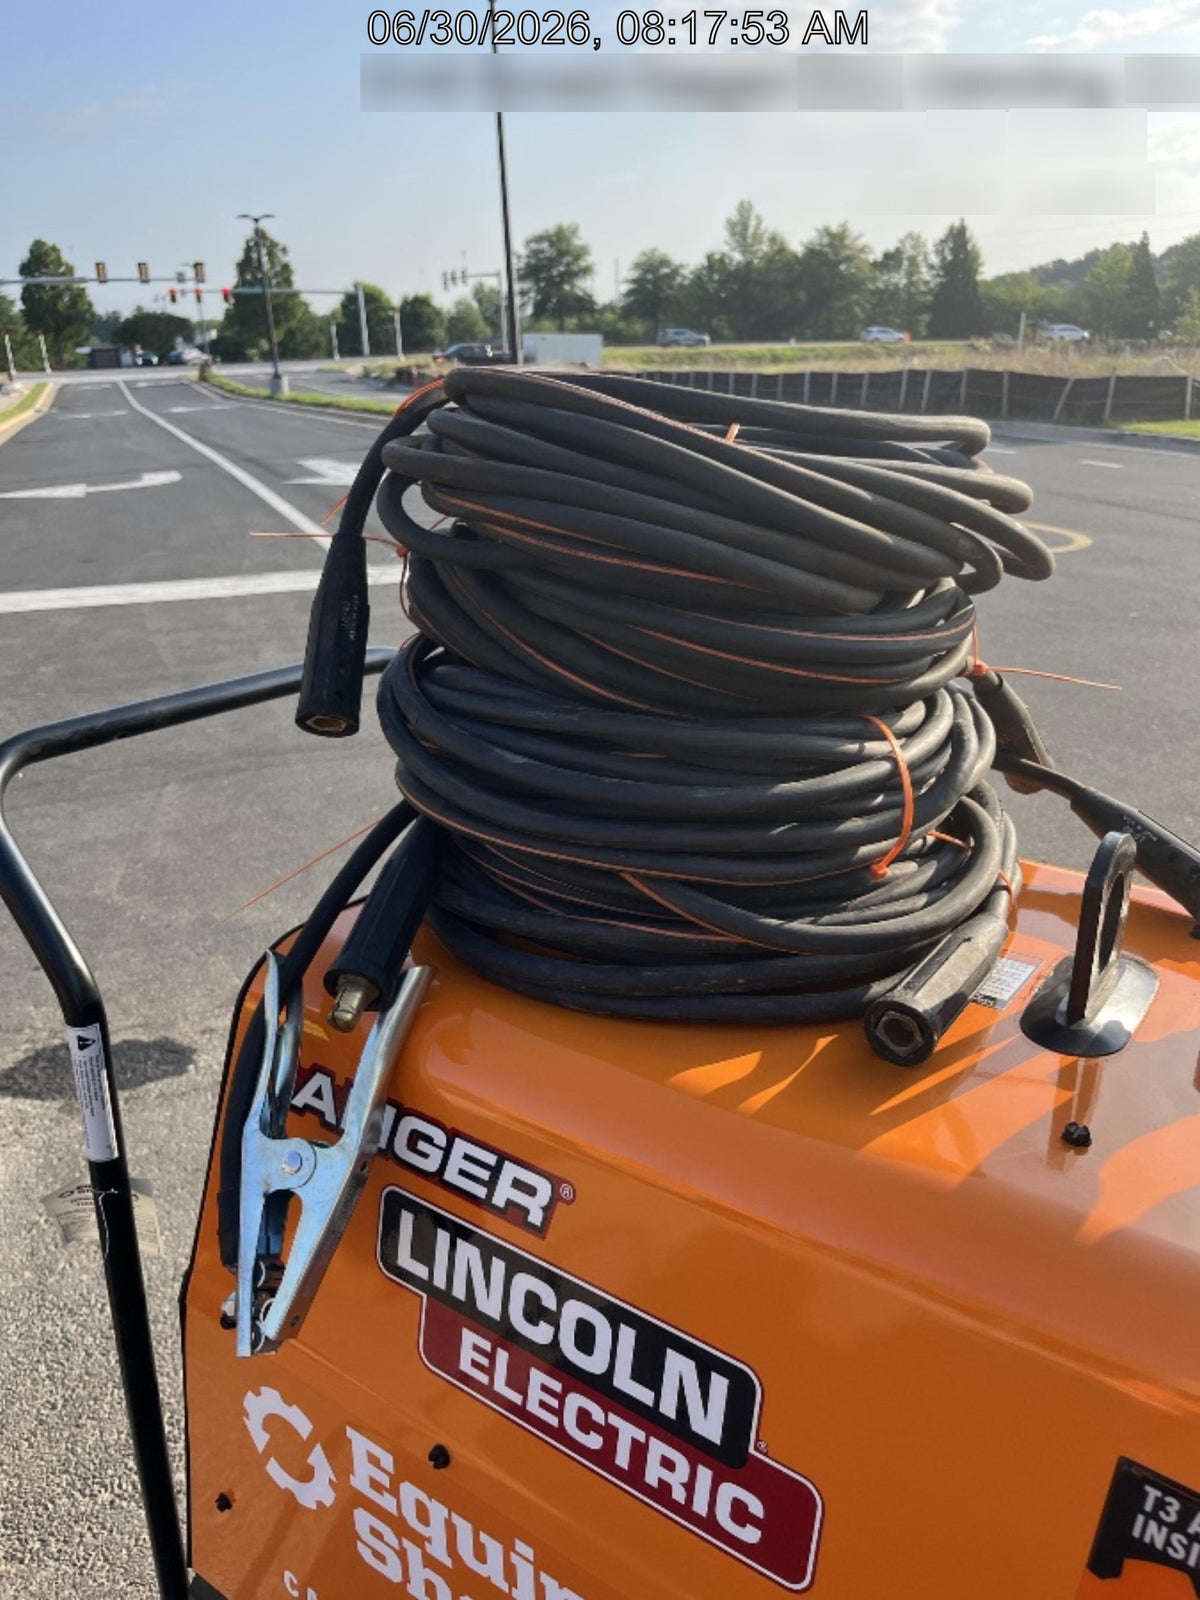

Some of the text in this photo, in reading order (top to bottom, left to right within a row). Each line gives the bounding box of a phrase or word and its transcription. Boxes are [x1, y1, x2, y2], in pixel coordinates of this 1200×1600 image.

[290, 1071, 553, 1228] AGER
[396, 1208, 730, 1446] LINCOLN
[459, 1326, 765, 1545] ELECTRIC
[1142, 1484, 1181, 1523] T3
[353, 1506, 474, 1600] Sh
